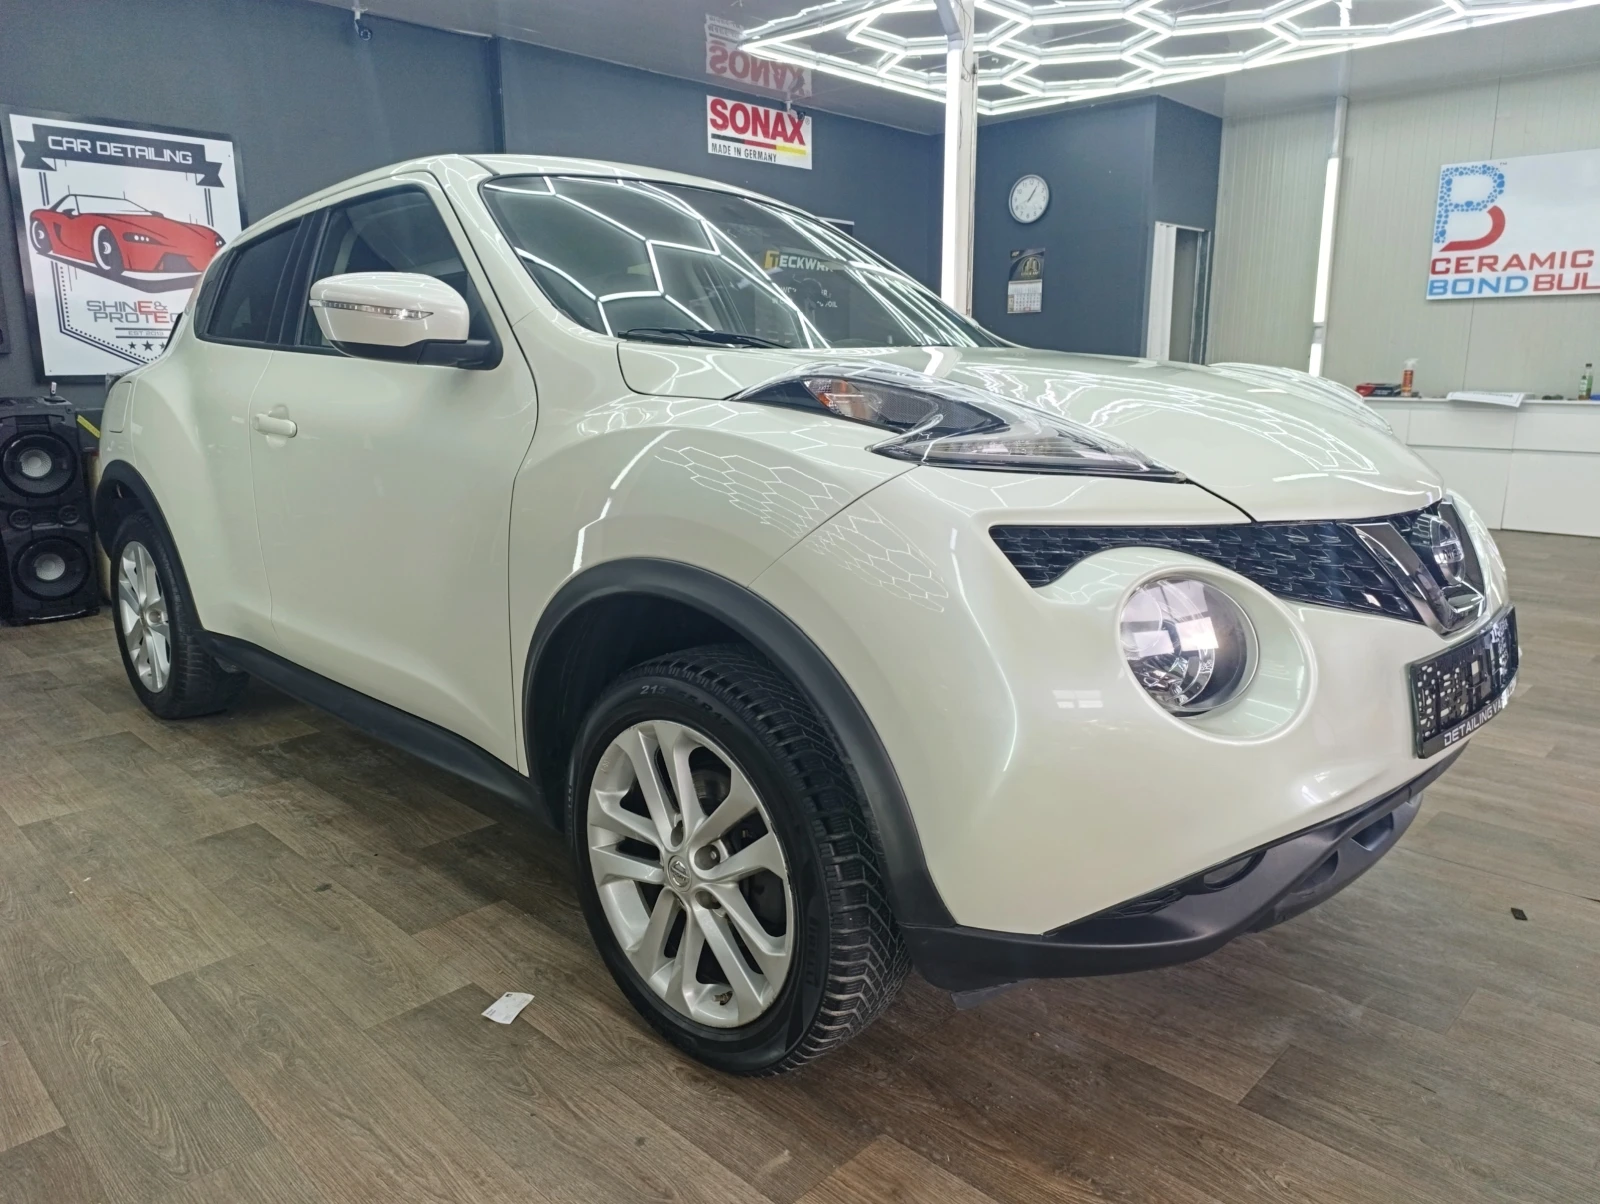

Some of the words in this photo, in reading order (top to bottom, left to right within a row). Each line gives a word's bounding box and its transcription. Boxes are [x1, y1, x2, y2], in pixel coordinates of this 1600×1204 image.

[710, 98, 806, 146] SONAX
[47, 135, 92, 154] CAR
[96, 141, 193, 165] DETAILING
[711, 142, 731, 155] MADE
[734, 147, 742, 157] IN
[744, 149, 777, 163] GERMANY
[1430, 249, 1595, 275] CERAMIC
[640, 685, 668, 695] 215
